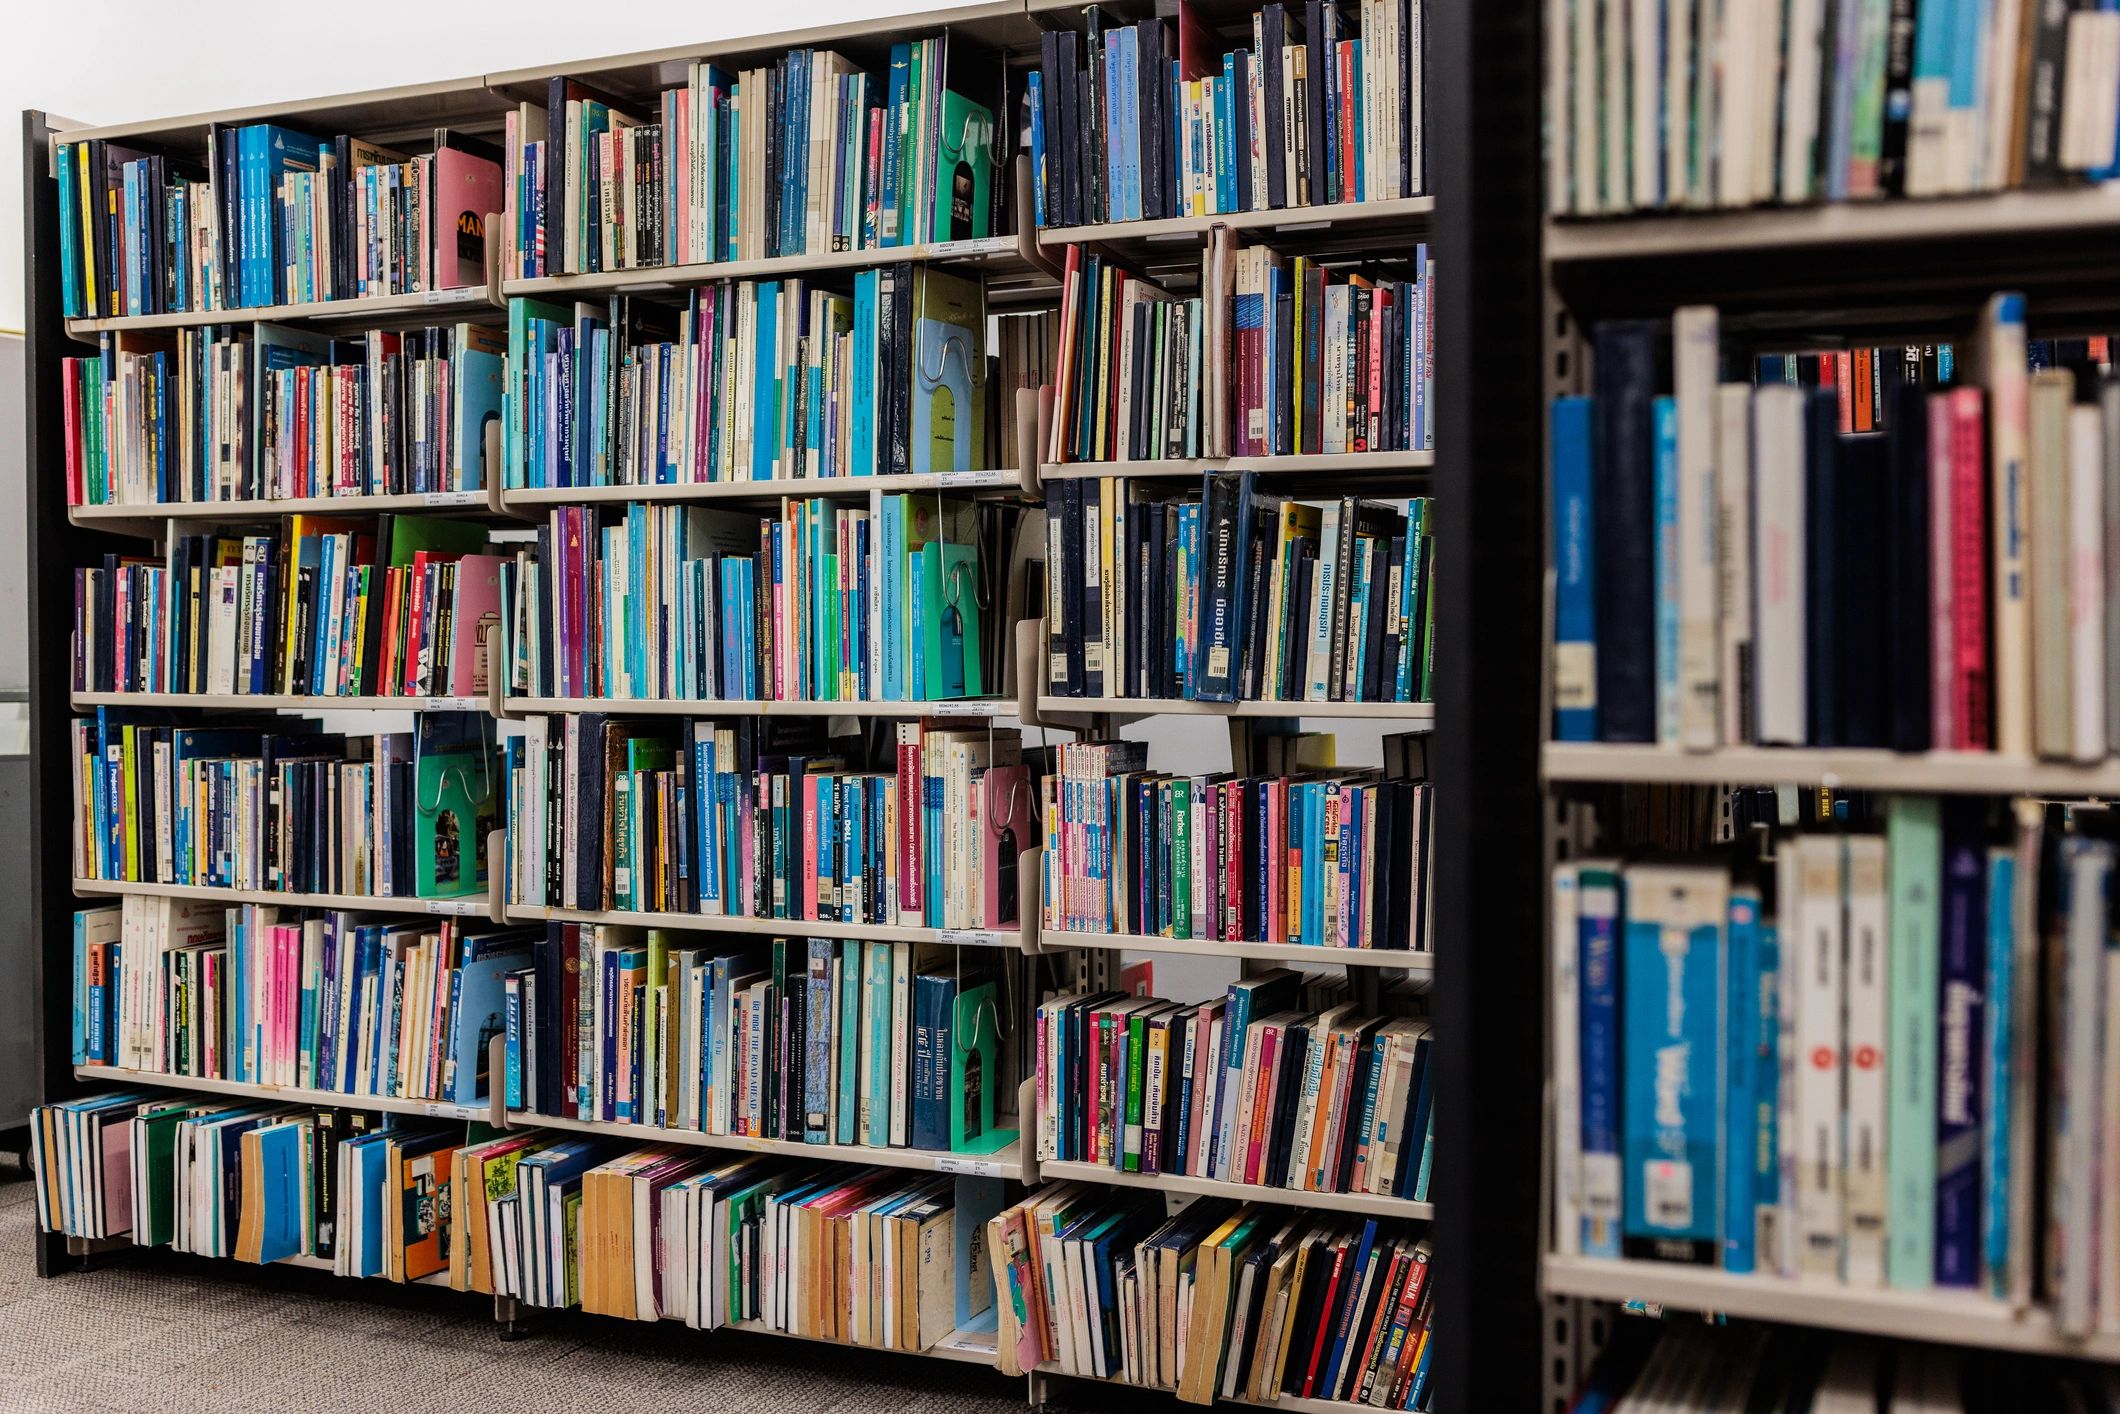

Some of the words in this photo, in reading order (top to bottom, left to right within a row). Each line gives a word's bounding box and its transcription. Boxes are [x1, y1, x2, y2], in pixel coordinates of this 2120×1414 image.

[602, 135, 610, 178] KEIRETSU
[411, 168, 420, 205] Organizing
[411, 207, 420, 232] Genius
[1334, 345, 1343, 392] นายทุนไทย
[1216, 529, 1230, 589] นักบริหาร
[1319, 563, 1332, 638] การประกอบธุรกิจ
[242, 573, 252, 655] การบริหารธุรกิจขนาดย่อ
[833, 783, 841, 791] 11
[833, 792, 842, 815] แม่ทัพ
[1822, 798, 1830, 817] BIBLE
[1176, 810, 1186, 837] Forbes
[1330, 800, 1339, 835] Networking
[752, 1000, 763, 1011] บิล
[751, 1034, 760, 1052] THE
[917, 1049, 932, 1058] ปี
[1184, 1038, 1193, 1061] NAPOLEON
[750, 1054, 759, 1078] ROAD
[935, 1027, 948, 1100] ในหลวงกับประชาชน
[1183, 1061, 1191, 1075] HILL
[1367, 1061, 1381, 1091] EMPIRE
[749, 1079, 759, 1109] AHEAD
[1367, 1092, 1377, 1104] OF
[1361, 1104, 1376, 1139] FREEDOM
[1239, 1123, 1248, 1145] KAZUO
[1235, 1144, 1245, 1172] INAMORI
[1406, 1281, 1419, 1300] MLM
[1386, 1296, 1396, 1315] BUSINESS
[1382, 1315, 1391, 1330] SCHOOL
